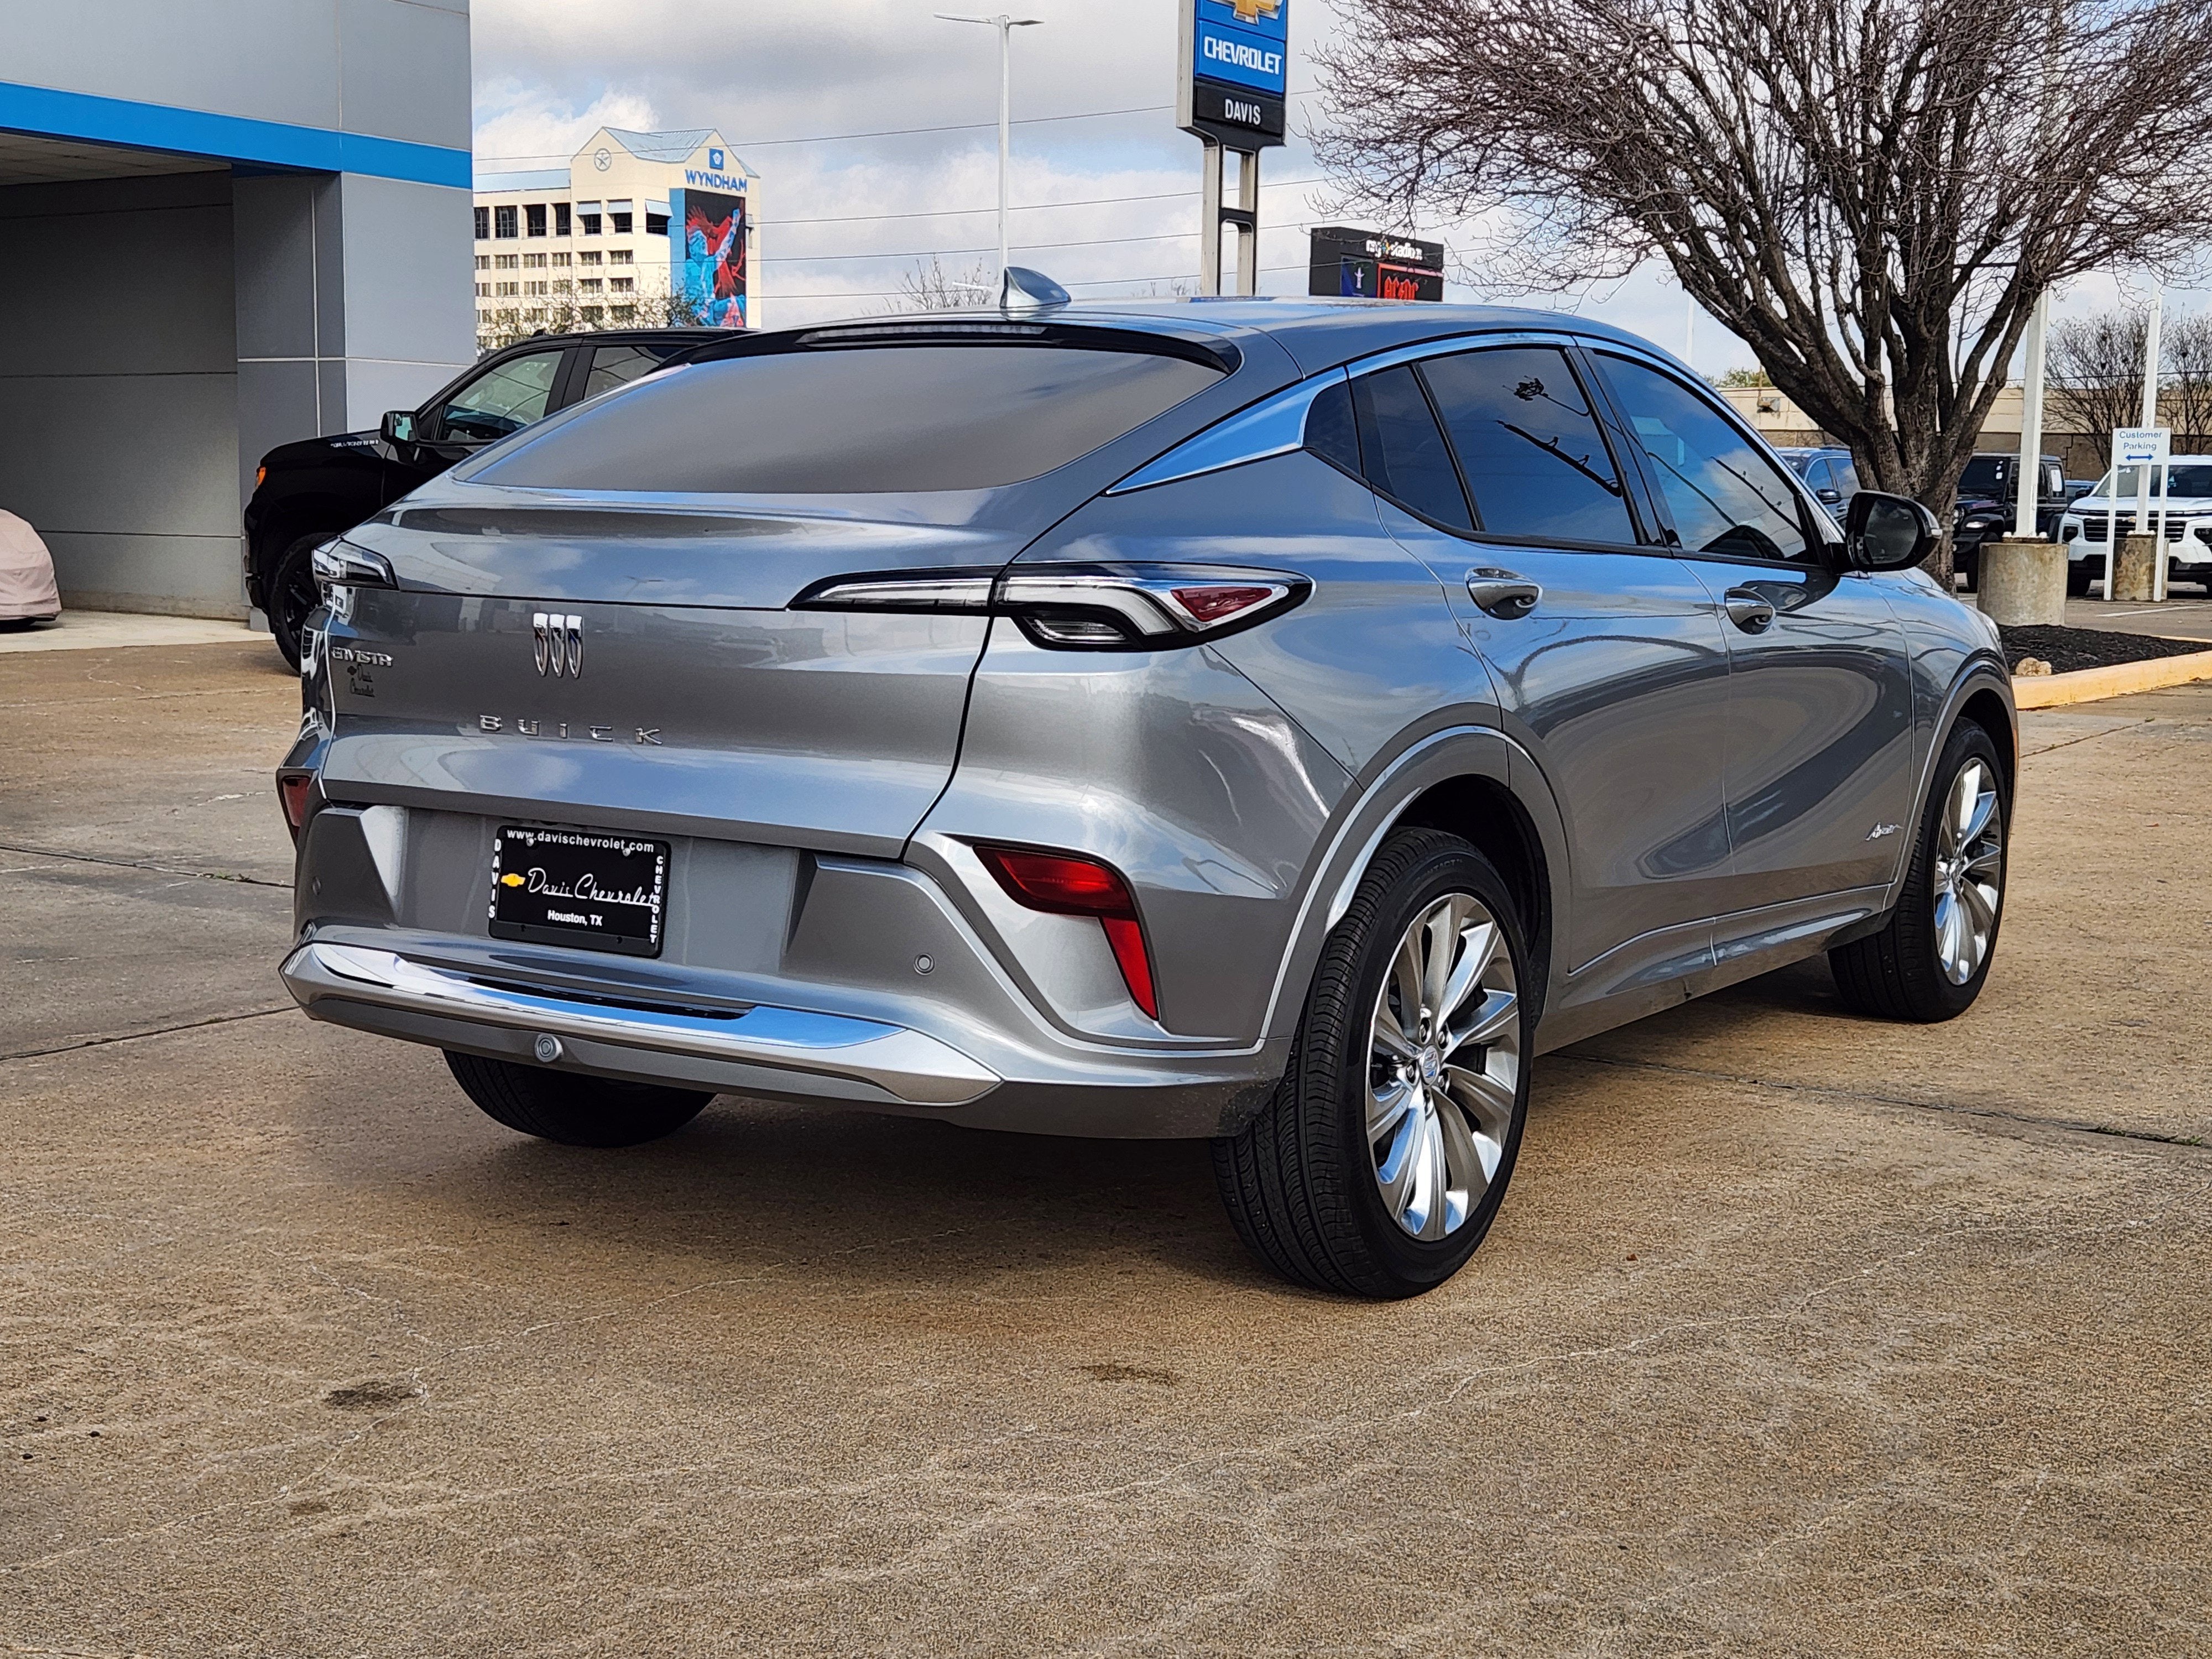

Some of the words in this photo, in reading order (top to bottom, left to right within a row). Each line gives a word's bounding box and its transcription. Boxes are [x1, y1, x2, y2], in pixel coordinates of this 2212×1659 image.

[1204, 36, 1282, 75] CHEVROLET
[1224, 98, 1261, 125] DAVIS
[685, 169, 747, 192] WYNDHAM
[2123, 442, 2157, 451] Parking
[479, 714, 663, 744] BUICK
[507, 829, 654, 853] www.davischevroletcom
[488, 838, 502, 919] DAVIS
[527, 867, 573, 898] Davis
[574, 873, 655, 907] Chevrolet
[649, 855, 664, 943] CHEVROLET
[547, 910, 588, 926] Houston,
[589, 914, 603, 926] TX
